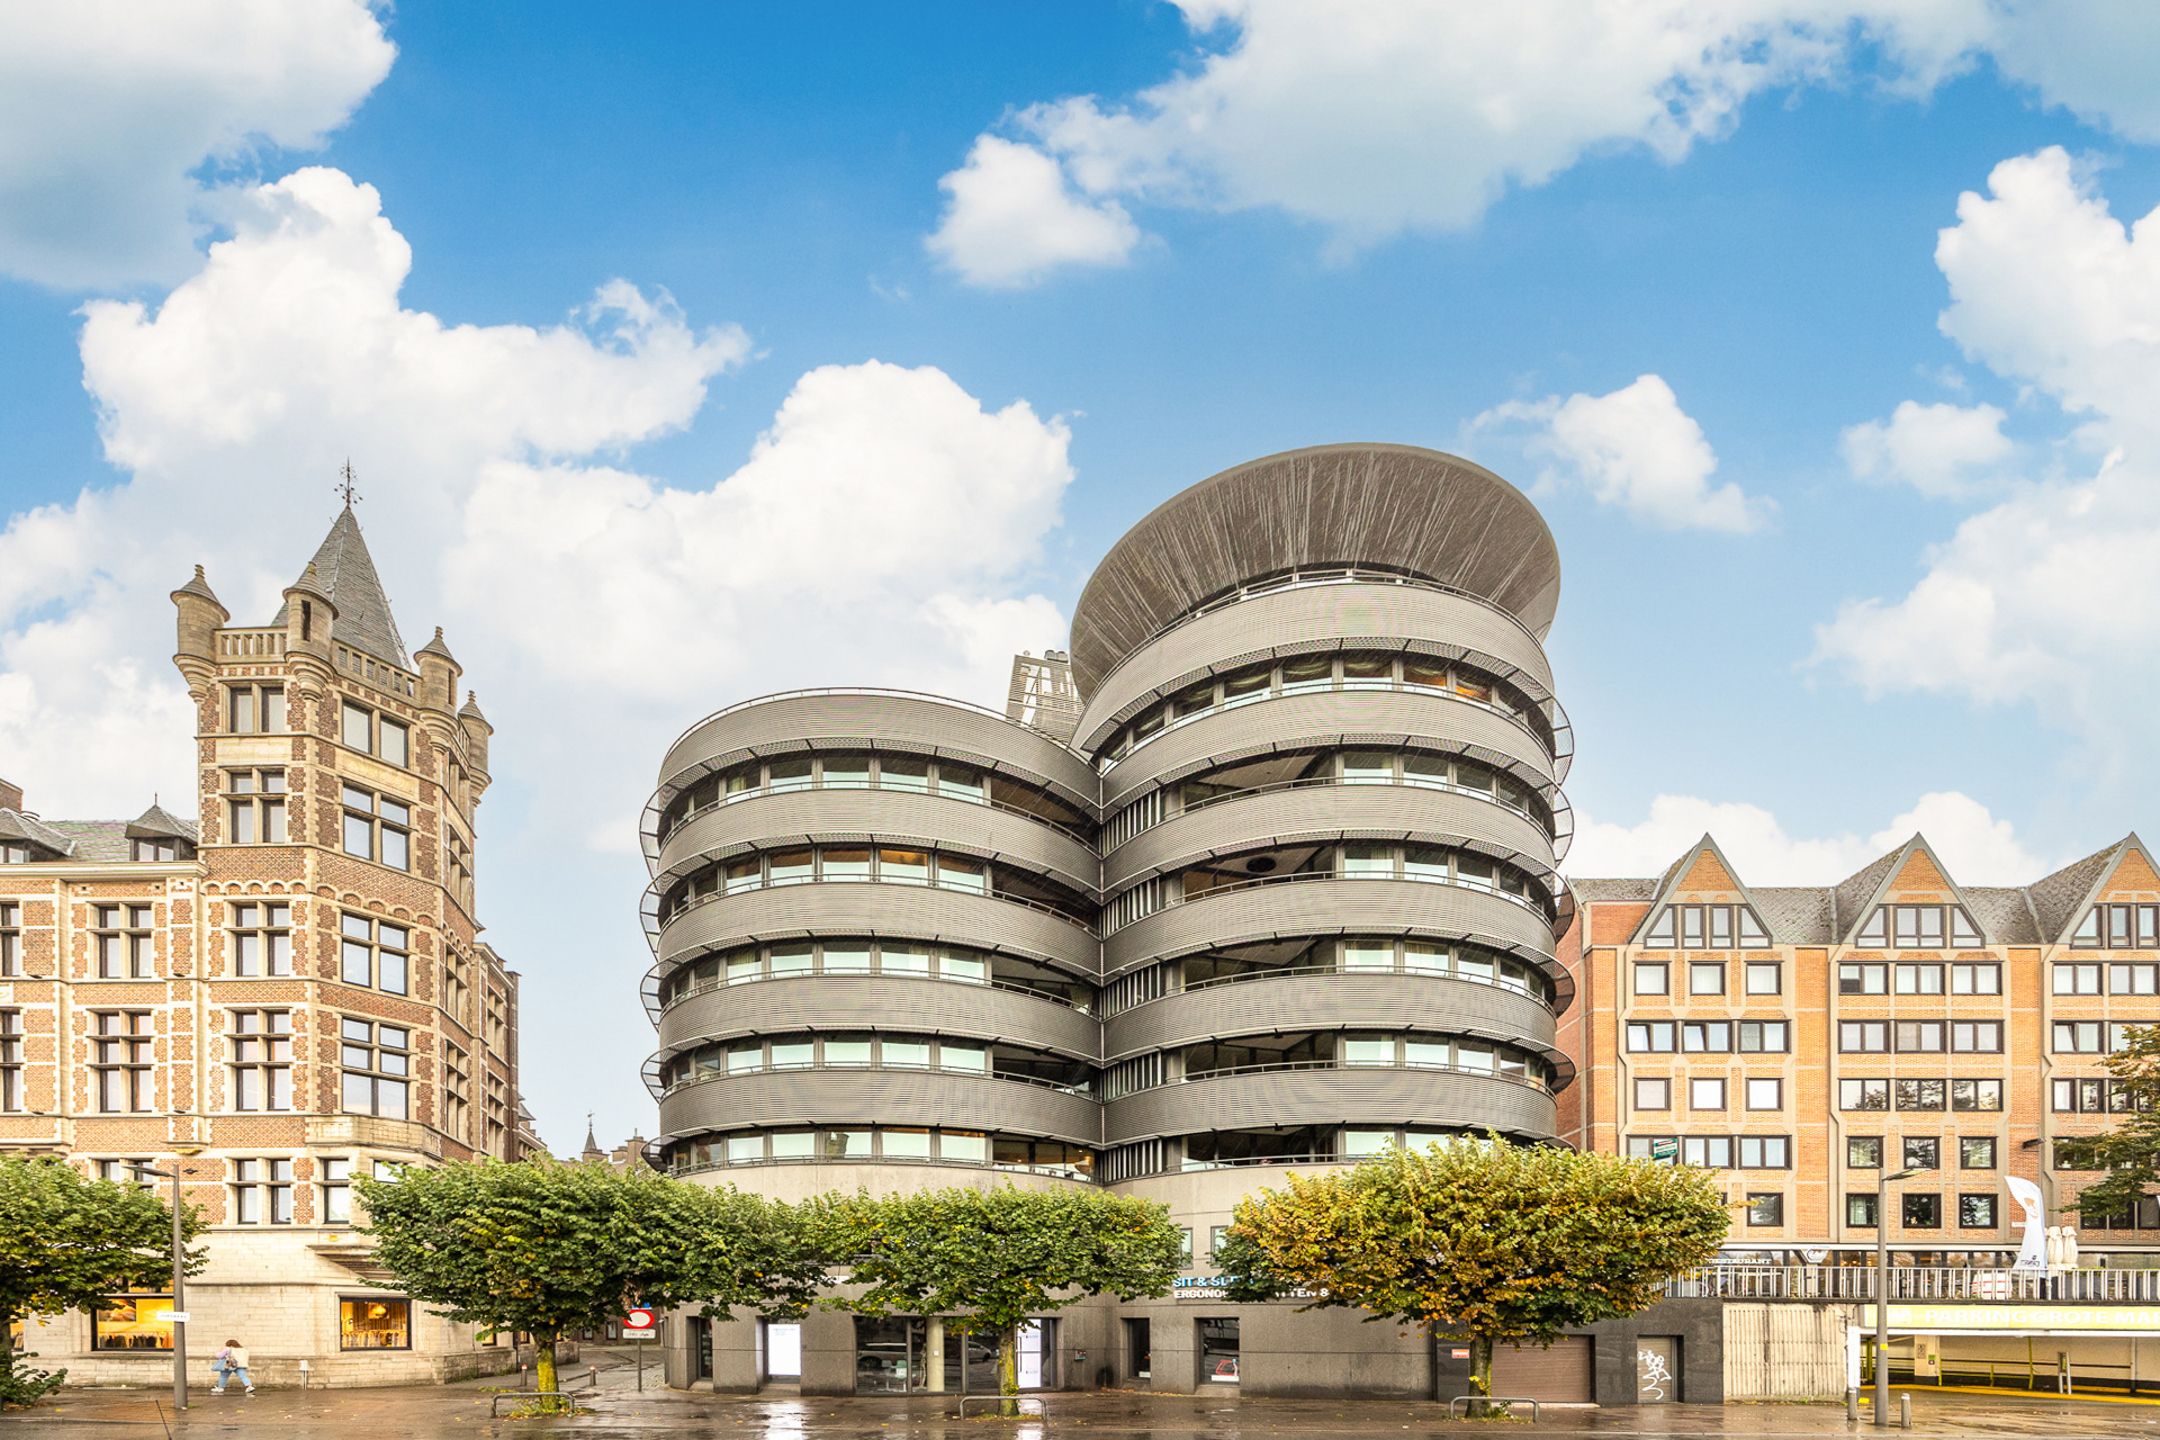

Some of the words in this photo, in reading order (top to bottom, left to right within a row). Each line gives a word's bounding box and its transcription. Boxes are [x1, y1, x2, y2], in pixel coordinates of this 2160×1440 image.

[1173, 1277, 1194, 1287] SIT
[1197, 1277, 1207, 1287] &
[1925, 1309, 2027, 1324] PARKING
[2030, 1310, 2110, 1325] GROTE
